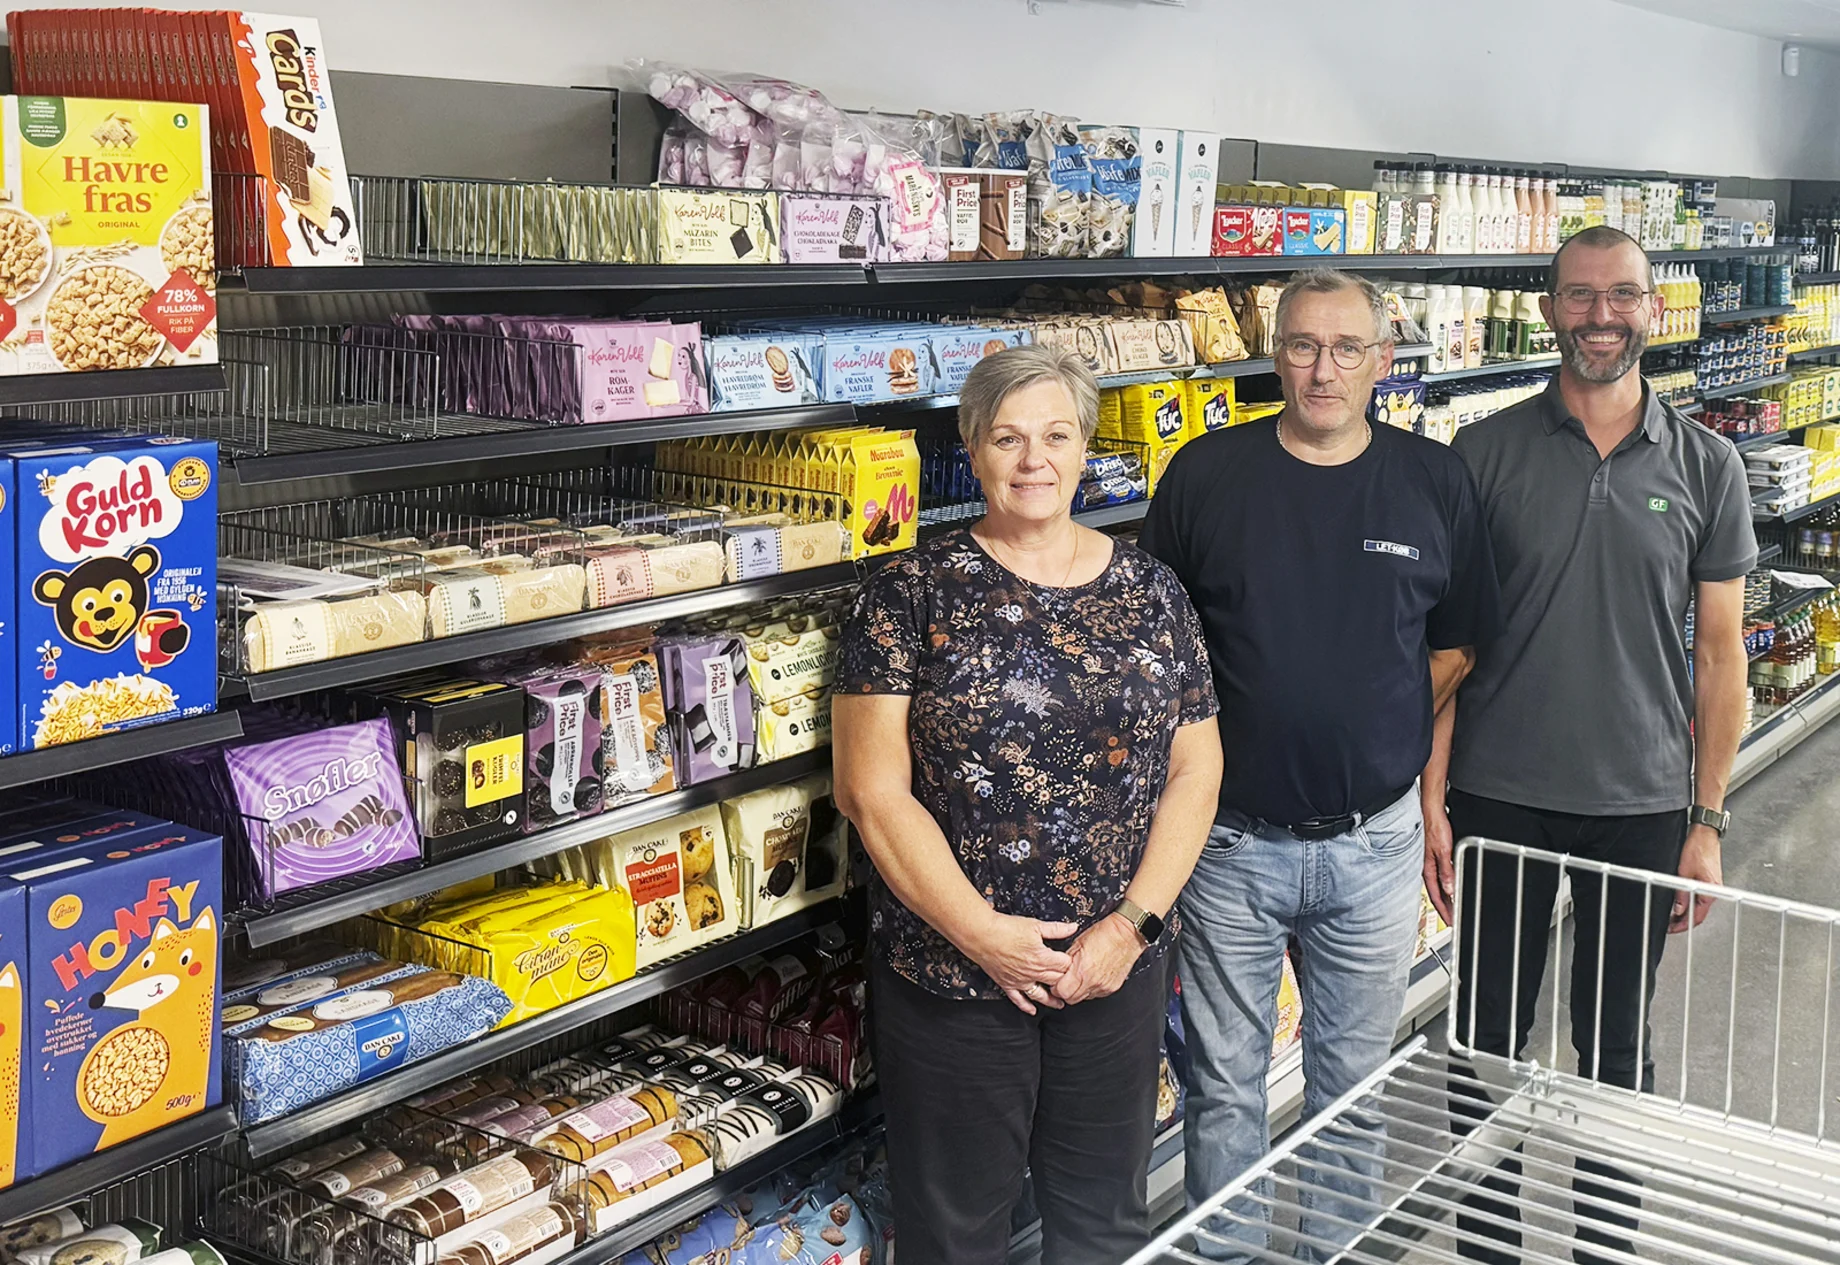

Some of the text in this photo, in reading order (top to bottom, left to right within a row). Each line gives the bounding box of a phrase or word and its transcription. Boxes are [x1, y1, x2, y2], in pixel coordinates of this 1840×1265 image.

[304, 46, 320, 93] Kinder
[265, 32, 318, 129] Cards
[62, 156, 168, 183] Havre
[83, 184, 153, 213] fras
[957, 189, 975, 198] First
[1014, 190, 1026, 199] Firs
[674, 203, 701, 222] Karen
[957, 199, 977, 208] Price
[1014, 200, 1026, 208] Pric
[98, 221, 140, 229] ORIGINAL
[796, 209, 821, 225] Karen
[684, 229, 718, 238] MAZARIN
[165, 289, 198, 303] 78%
[157, 304, 205, 314] FULLKORN
[184, 316, 195, 324] PÅ
[588, 345, 644, 366] Karen Volf
[714, 354, 742, 372] Karen
[833, 354, 863, 373] Karen
[845, 376, 874, 385] FRANSKE
[849, 384, 874, 393] VAFLER
[607, 386, 635, 395] KAGER
[1157, 407, 1181, 432] TUC
[1205, 401, 1228, 426] TUC
[870, 447, 904, 462] Marabou
[876, 469, 904, 481] Brownie
[67, 465, 152, 518] Guld
[1651, 499, 1666, 508] GF
[61, 498, 163, 554] Korn
[709, 663, 720, 694] Price
[717, 661, 728, 689] First
[613, 683, 624, 715] Price
[622, 681, 633, 710] First
[559, 703, 570, 737] Price
[568, 701, 579, 731] First
[261, 751, 382, 821] Snøfler
[632, 838, 668, 853] DAN CAKE
[627, 862, 677, 882] STRACCIATELLA
[52, 877, 200, 992] HONEY
[45, 1017, 93, 1037] hvedekerner
[55, 1013, 85, 1026] Puffede
[41, 1031, 98, 1053] med sukker og
[46, 1025, 92, 1044] overtrukket
[364, 1033, 402, 1051] DAN CAKE
[165, 1094, 193, 1111] 500g
